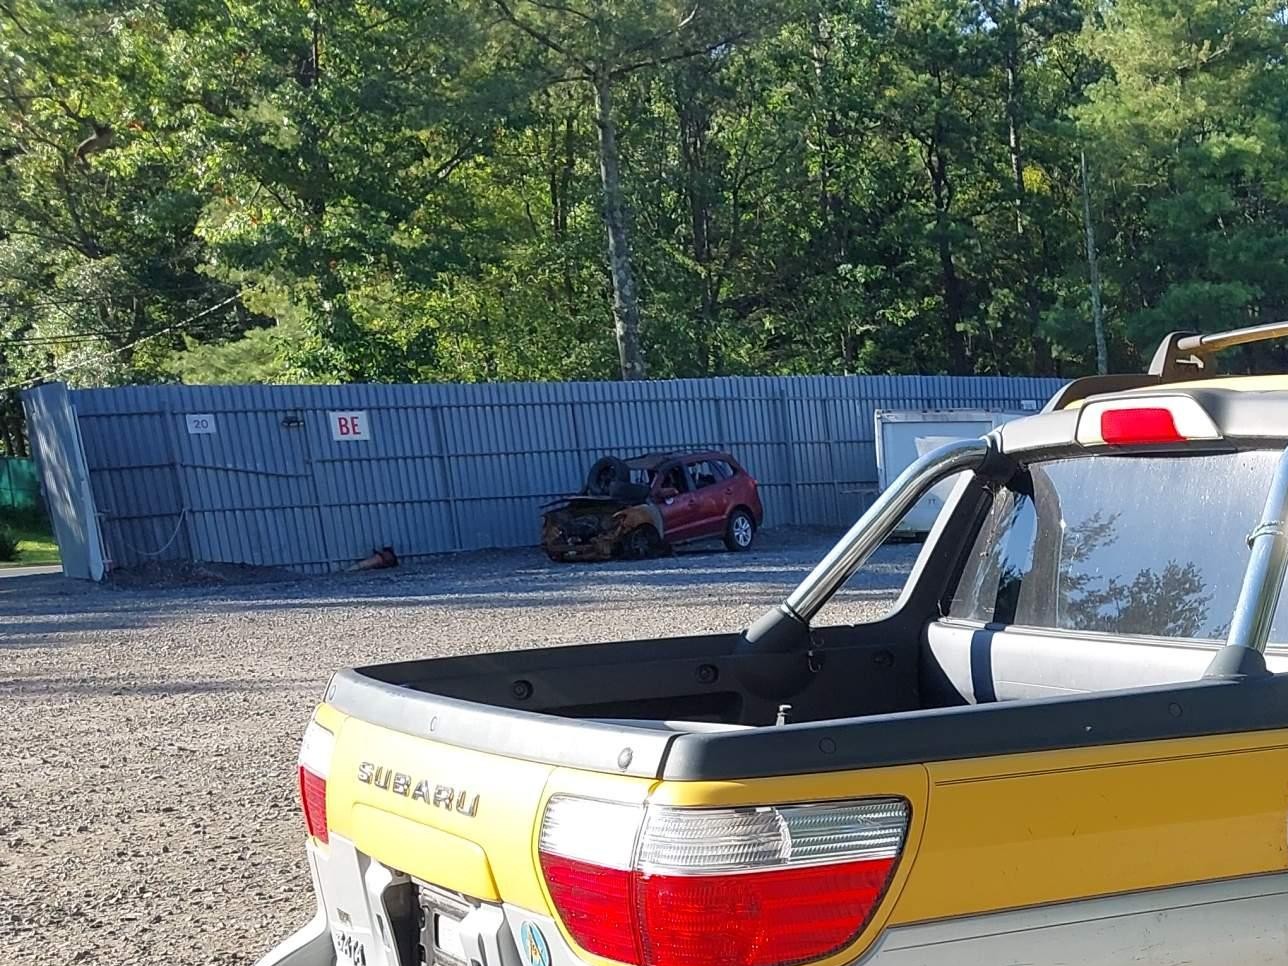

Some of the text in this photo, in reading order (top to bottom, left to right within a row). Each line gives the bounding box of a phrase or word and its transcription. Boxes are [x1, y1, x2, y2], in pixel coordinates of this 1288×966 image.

[193, 419, 209, 429] 20
[338, 416, 361, 436] BE
[357, 761, 480, 818] SUBARU
